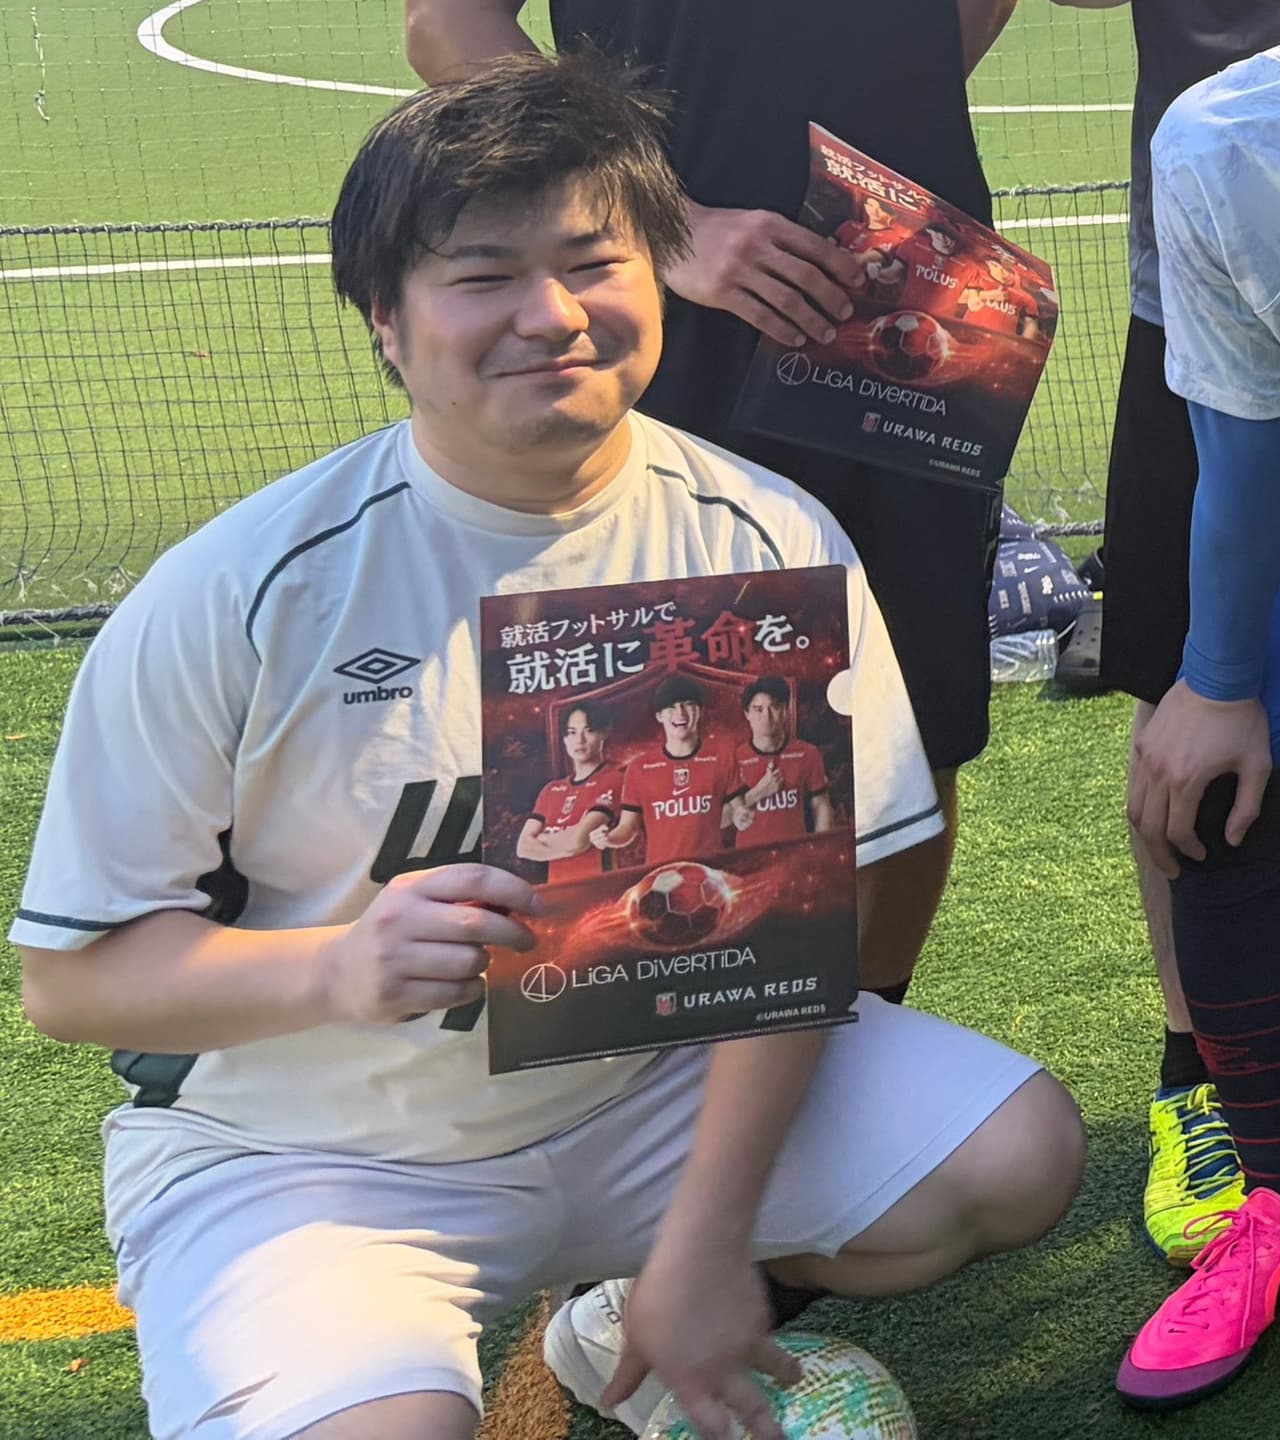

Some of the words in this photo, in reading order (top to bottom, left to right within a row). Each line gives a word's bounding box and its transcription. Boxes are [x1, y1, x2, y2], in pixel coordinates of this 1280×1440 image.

[915, 264, 958, 289] POLUS
[883, 421, 936, 445] URAWA
[942, 437, 982, 457] REDS
[500, 601, 677, 649] 就活フットサルで
[507, 610, 810, 696] 就活に革命を。
[344, 685, 413, 705] umbro
[652, 795, 713, 820] POLUS
[683, 986, 756, 1008] URAWA
[764, 976, 818, 996] REDS
